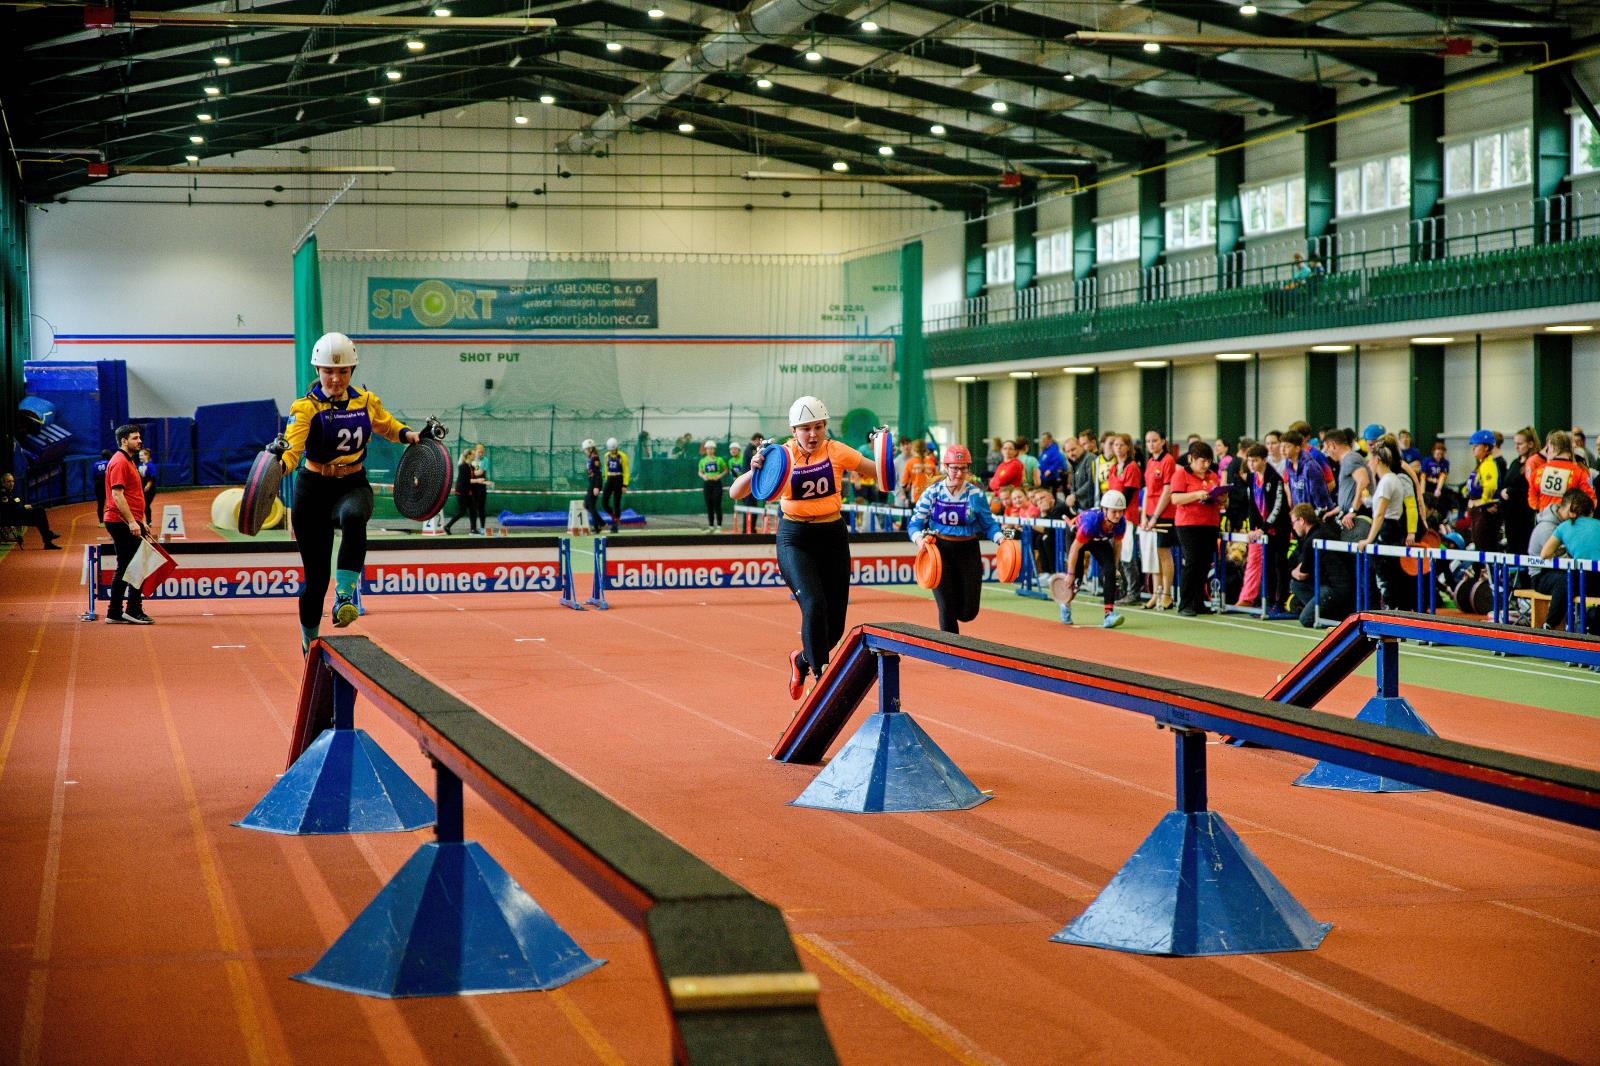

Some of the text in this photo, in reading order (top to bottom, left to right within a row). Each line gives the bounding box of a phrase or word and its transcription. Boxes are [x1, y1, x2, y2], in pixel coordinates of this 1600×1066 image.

[510, 283, 645, 296] SPORT JABLONEC s. r. o.
[371, 279, 497, 327] SPORT
[506, 312, 650, 327] www.sportjablonec.cz
[459, 352, 520, 362] SHOT PUT
[779, 364, 847, 373] WR INDOOR
[336, 426, 364, 452] 21
[801, 476, 829, 499] 20
[1544, 475, 1562, 492] 58
[167, 516, 179, 532] 4
[577, 512, 583, 526] 1
[938, 511, 959, 526] 19
[369, 565, 557, 593] Jablonec 2023
[610, 562, 724, 588] Jablonec
[850, 559, 917, 584] Jablo
[235, 570, 299, 595] 2023
